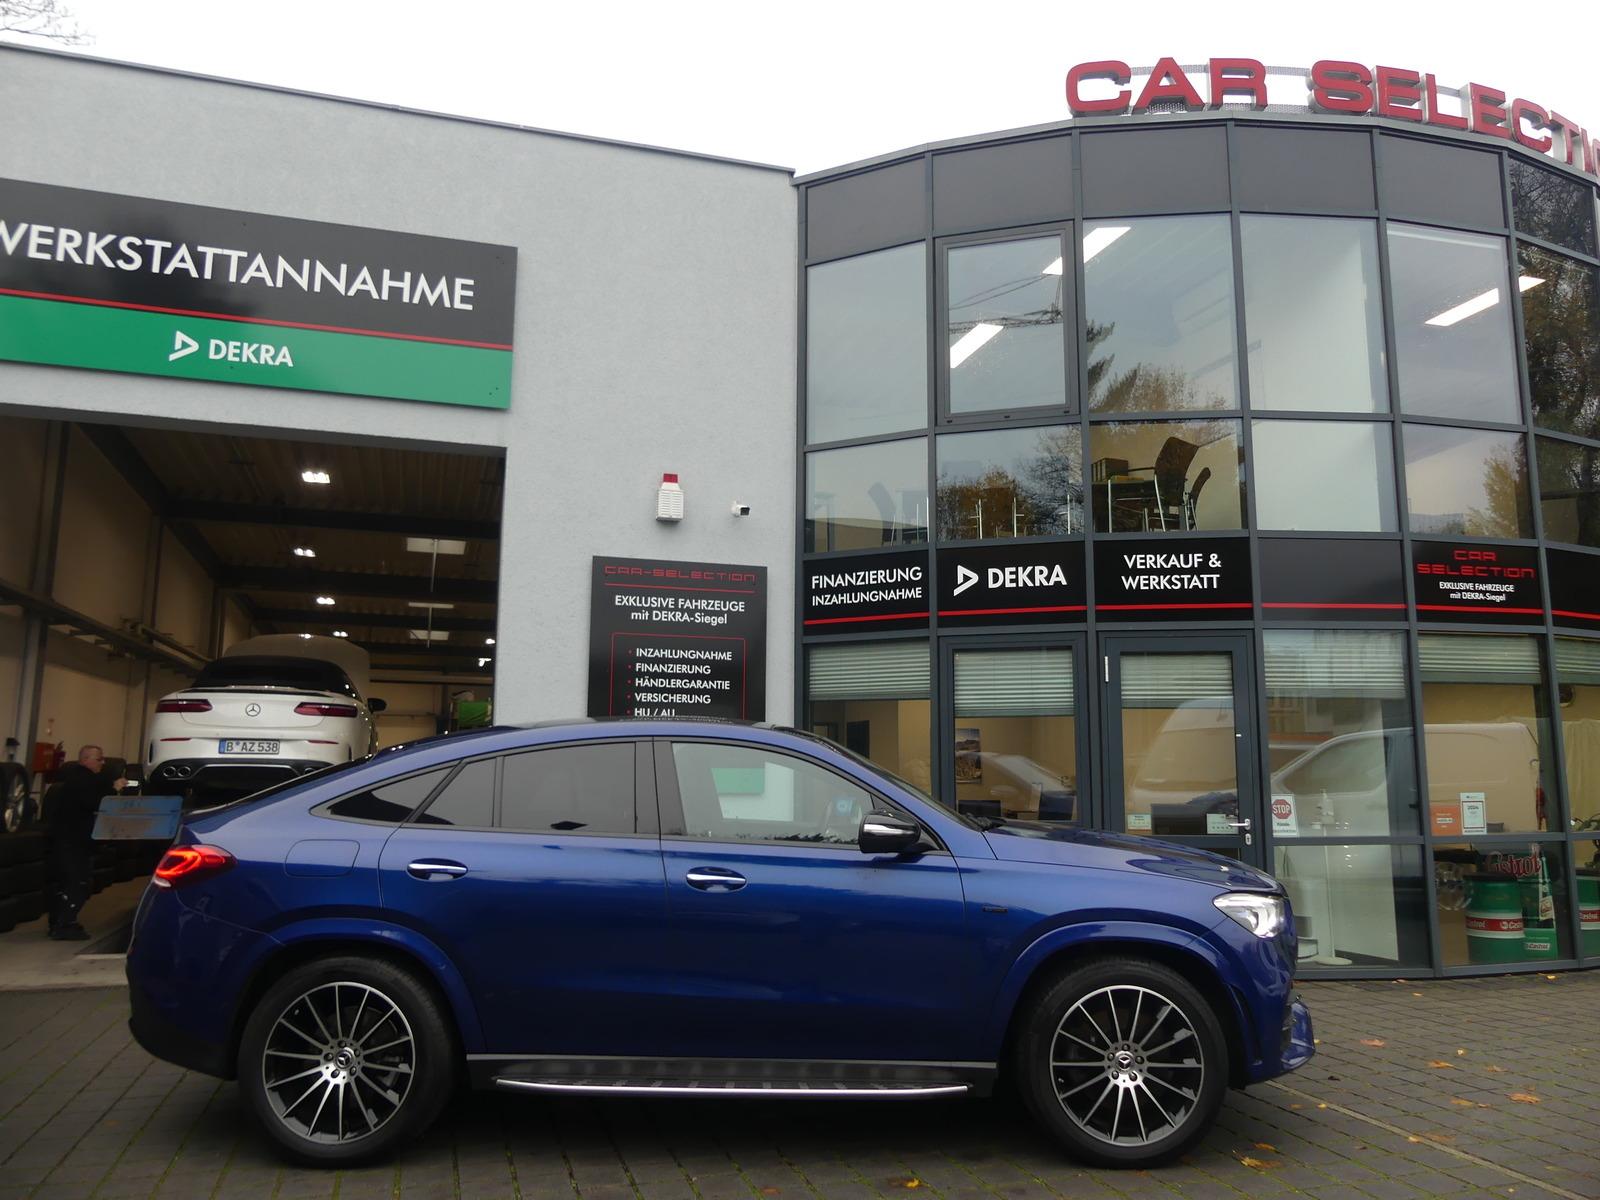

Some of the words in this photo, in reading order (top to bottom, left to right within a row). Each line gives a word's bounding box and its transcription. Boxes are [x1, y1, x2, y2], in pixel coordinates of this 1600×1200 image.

[1066, 57, 1268, 113] CAR
[208, 338, 294, 367] DEKRA
[1123, 553, 1203, 569] VERKAUF
[1208, 553, 1222, 568] &
[1454, 550, 1496, 561] CAR
[604, 566, 755, 582] CAR-SELECTION
[811, 566, 923, 589] FINANZIERUNG
[987, 564, 1067, 589] DEKRA
[1416, 563, 1535, 578] SELECTION
[1121, 574, 1220, 590] WERKSTATT
[1439, 581, 1474, 591] EXKLUSIVE
[1475, 583, 1515, 593] FAHRZEUGE
[615, 595, 675, 608] EXKLUSIVE
[678, 598, 745, 612] FAHRZEUGE
[811, 588, 923, 607] INZAHLUNGNAHME
[1462, 591, 1506, 602] DEKRA-Siegel
[631, 610, 649, 620] mit
[652, 610, 728, 626] DEKRA-Siegel
[636, 648, 732, 661] INZAHLUNGNAHME
[635, 663, 711, 675] FINANZIERUNG
[635, 676, 730, 690] HÄNDLERGARANTIE
[634, 692, 711, 704] VERSICHERUNG
[226, 741, 234, 752] B
[241, 741, 255, 752] AZ
[257, 741, 278, 753] 538
[1273, 804, 1290, 814] STOP
